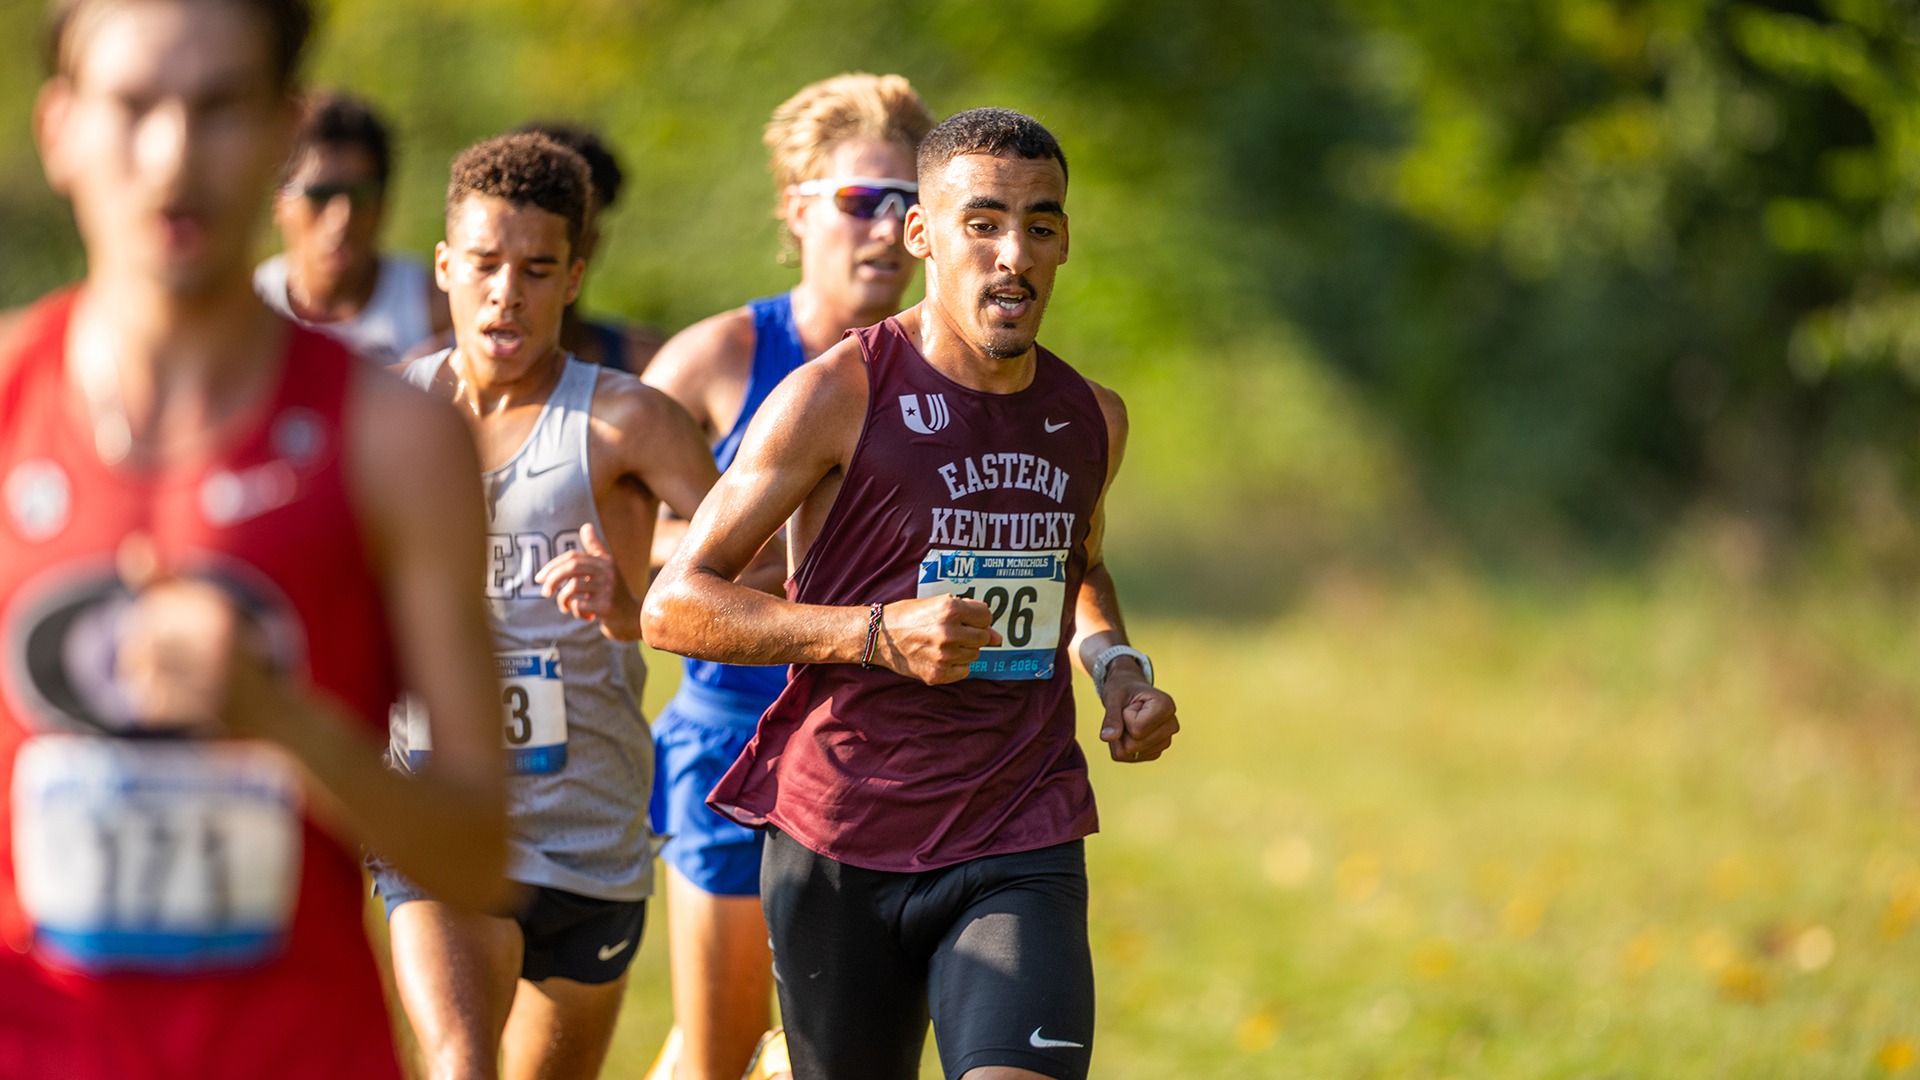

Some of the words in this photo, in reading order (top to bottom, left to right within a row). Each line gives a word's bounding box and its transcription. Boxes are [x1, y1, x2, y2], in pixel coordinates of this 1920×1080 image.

[937, 453, 1070, 504] EASTERN
[929, 508, 1076, 550] KENTUCKY
[947, 557, 976, 577] JM
[982, 558, 1004, 568] JOHN
[995, 568, 1034, 577] INVITATIONAL
[955, 586, 1038, 648] 26
[1010, 660, 1040, 672] 2026
